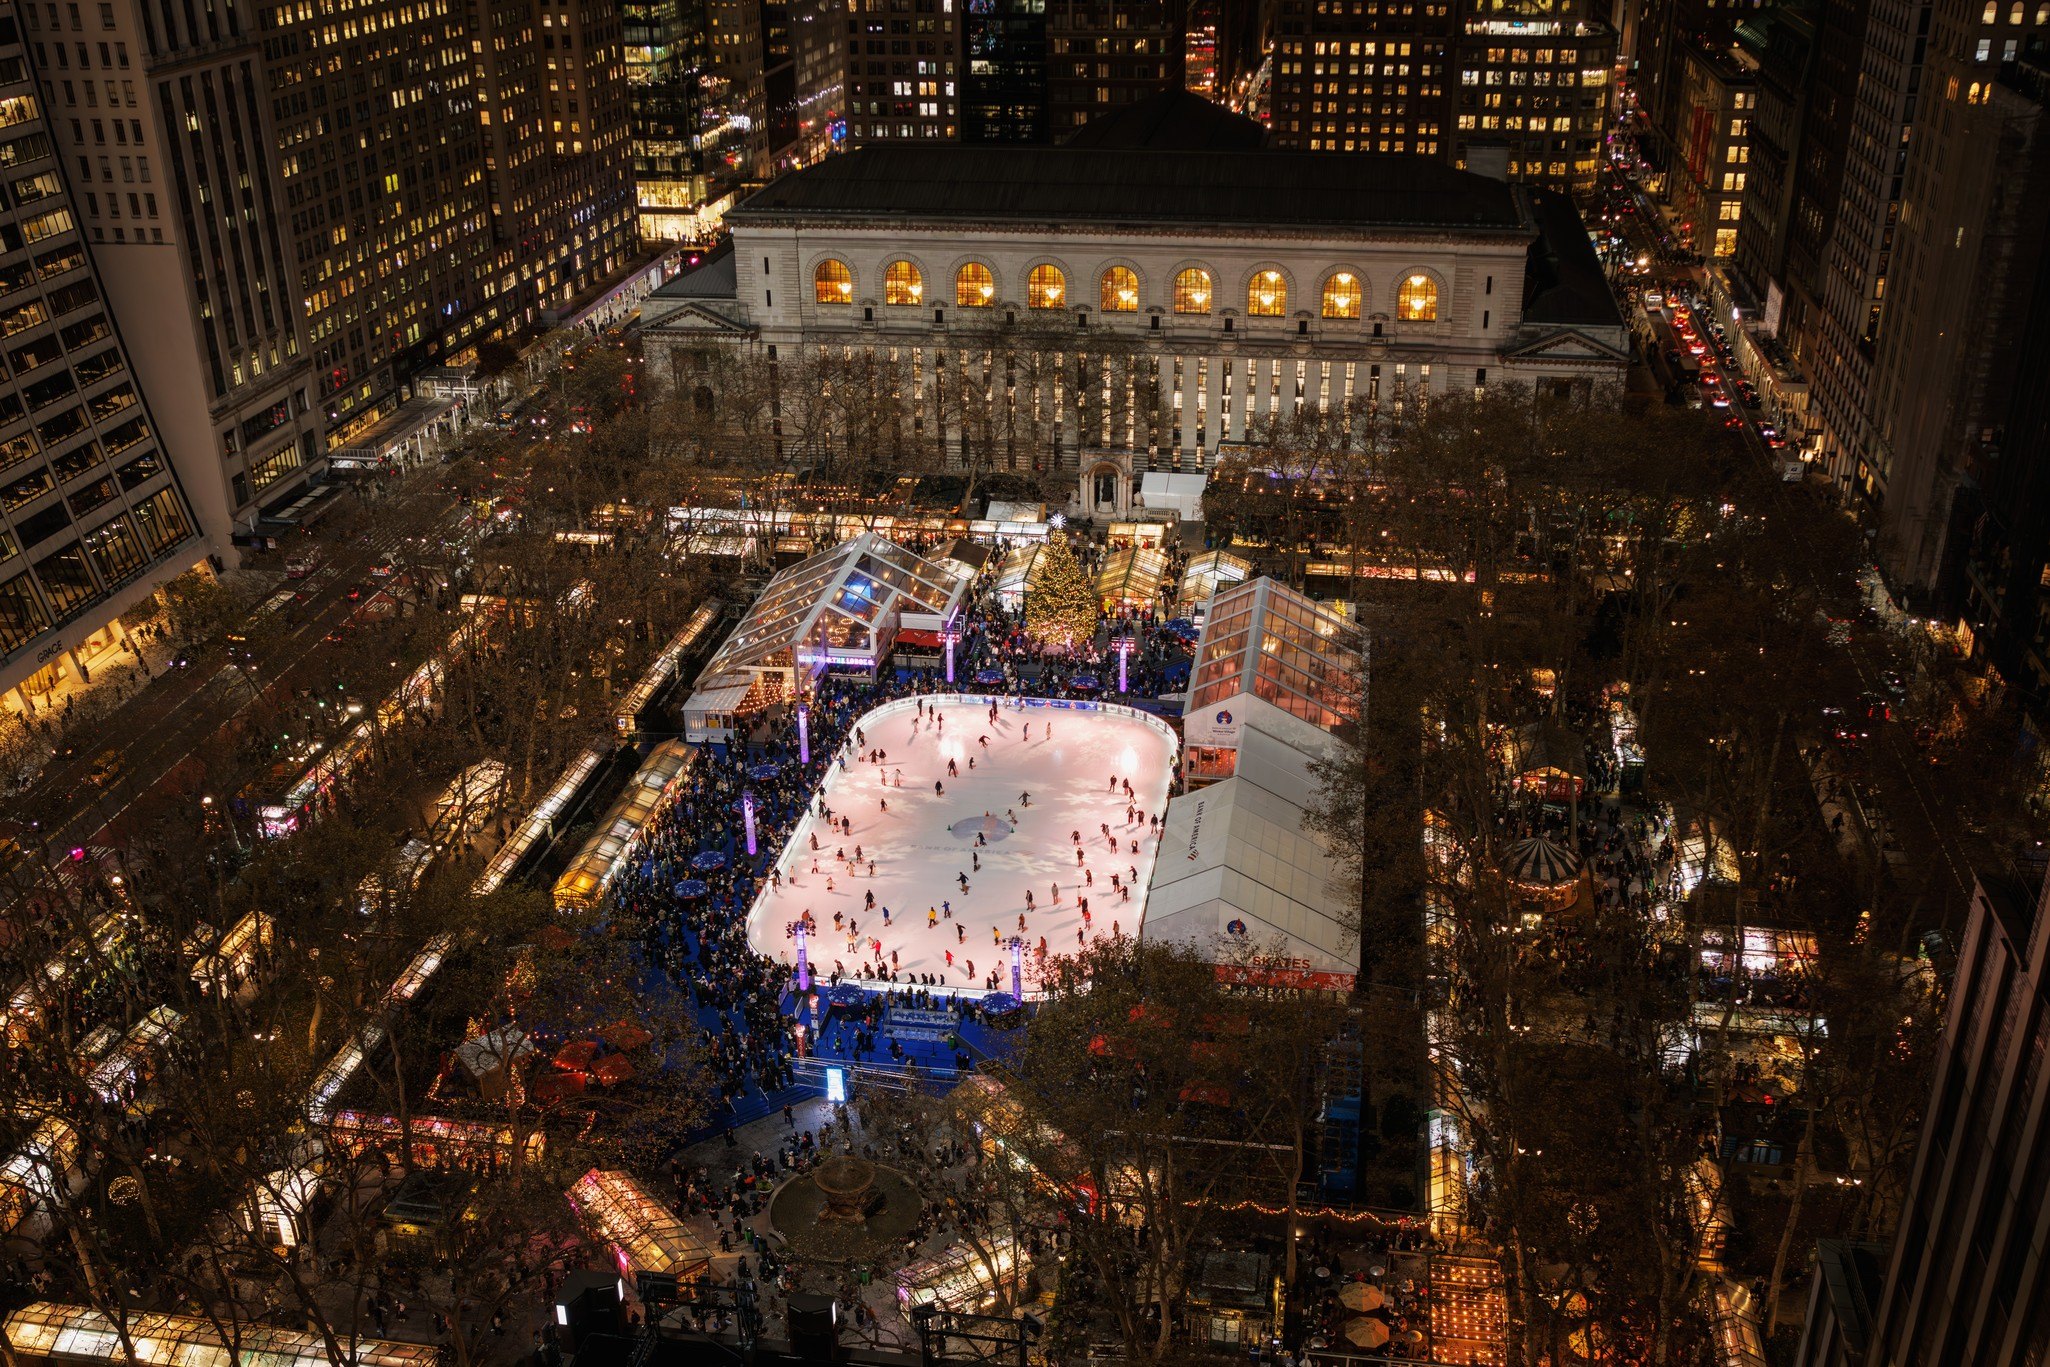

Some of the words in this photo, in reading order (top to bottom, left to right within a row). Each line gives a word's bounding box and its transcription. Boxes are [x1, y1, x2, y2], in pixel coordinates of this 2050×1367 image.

[37, 640, 62, 663] GRACE
[1196, 801, 1204, 816] BANK
[1189, 825, 1199, 851] AMERICA
[1253, 956, 1310, 969] SKATES
